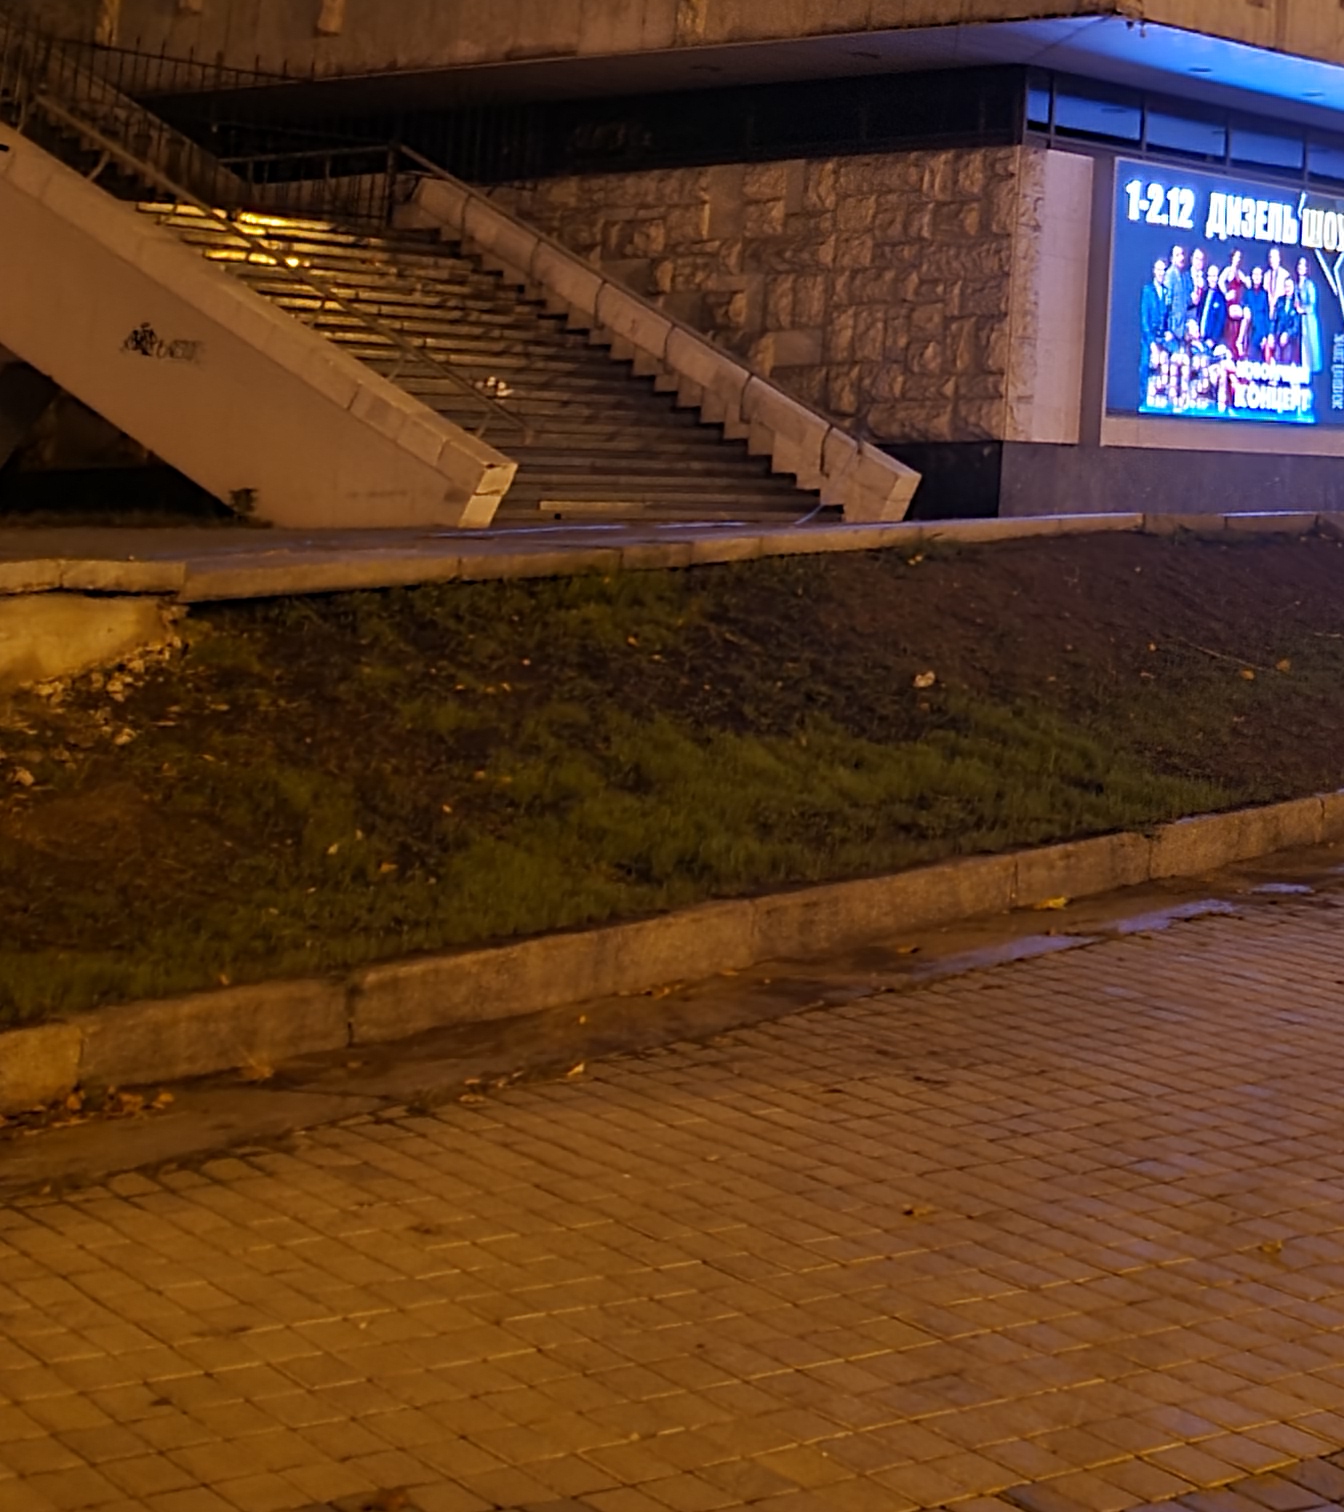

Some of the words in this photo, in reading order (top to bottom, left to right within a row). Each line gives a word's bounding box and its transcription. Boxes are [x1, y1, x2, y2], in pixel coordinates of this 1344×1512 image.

[1125, 180, 1194, 229] 1-2.12
[1205, 192, 1297, 245] ДИЗЕЛЬ
[1234, 383, 1311, 412] КОНЦЕРТ
